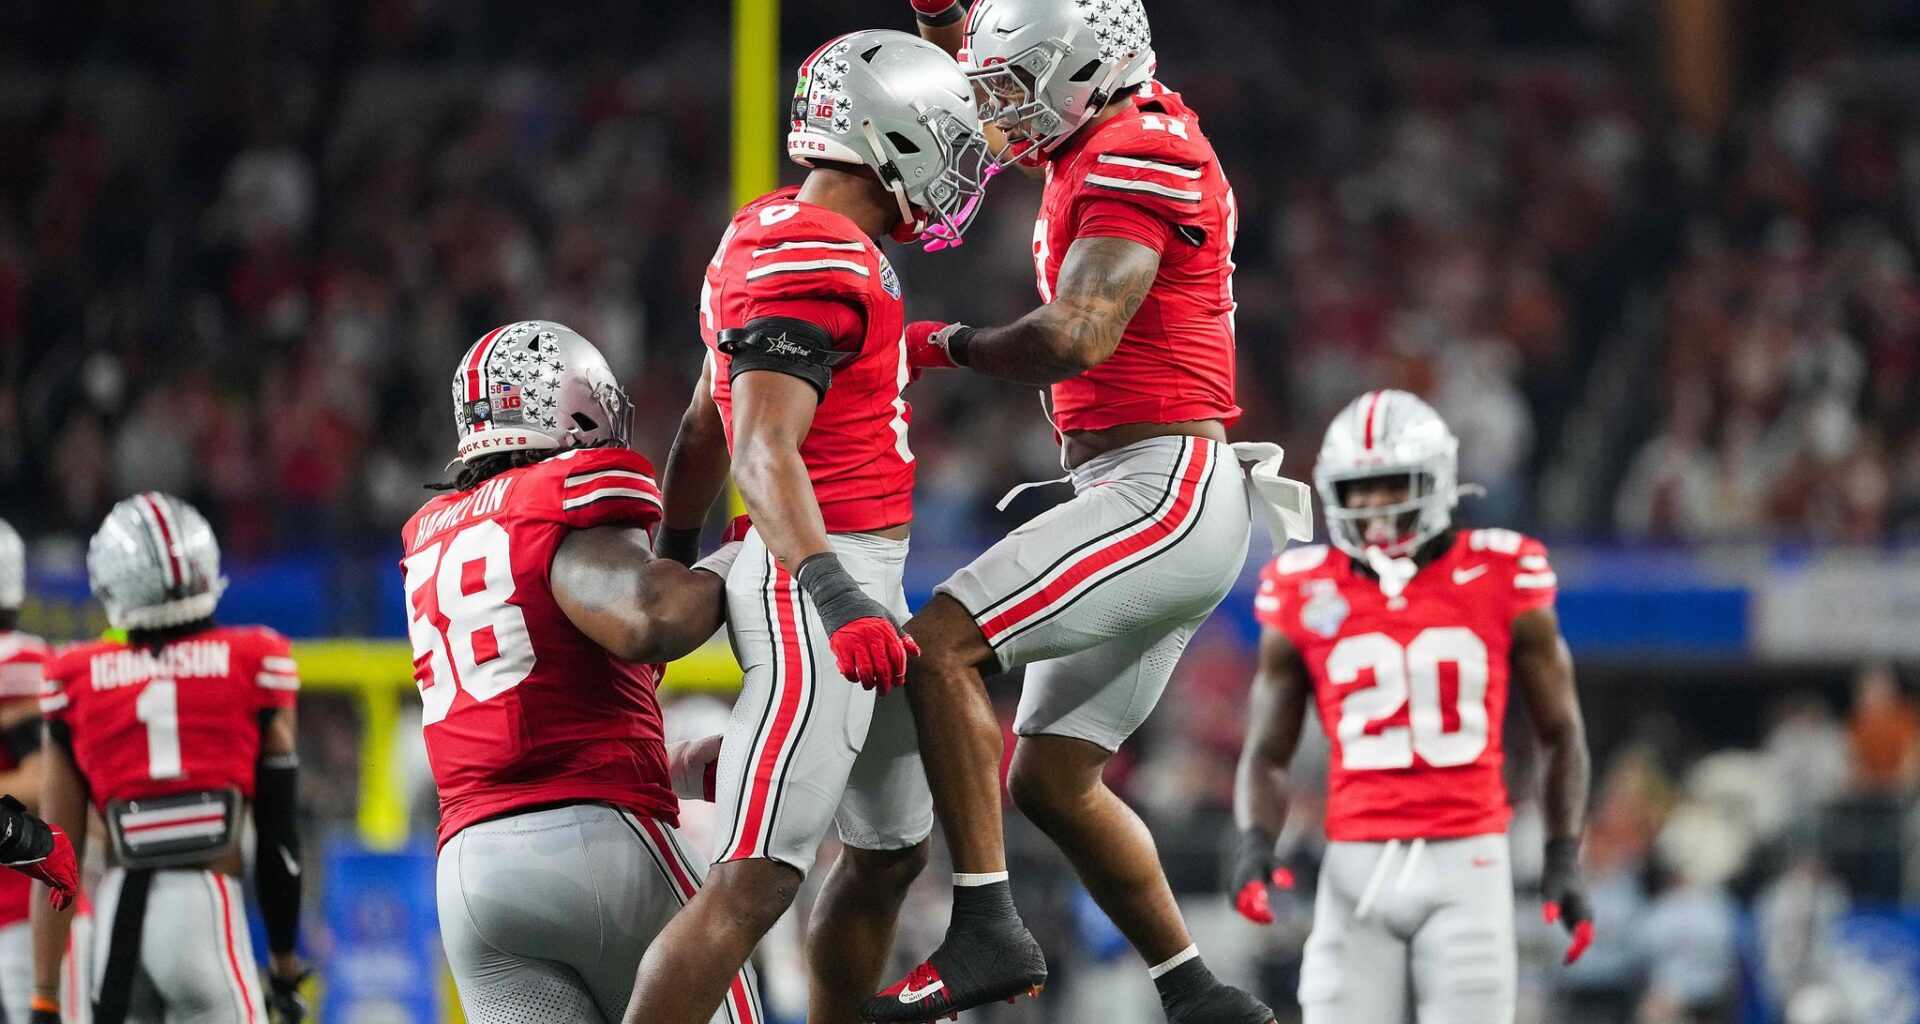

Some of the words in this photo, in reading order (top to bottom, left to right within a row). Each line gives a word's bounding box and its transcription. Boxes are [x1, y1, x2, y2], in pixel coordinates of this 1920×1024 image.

[490, 385, 502, 394] 58
[776, 341, 809, 356] Douglas
[413, 477, 513, 552] HAMILTON
[404, 518, 537, 727] 58
[136, 679, 181, 779] 1
[1326, 626, 1489, 770] 20
